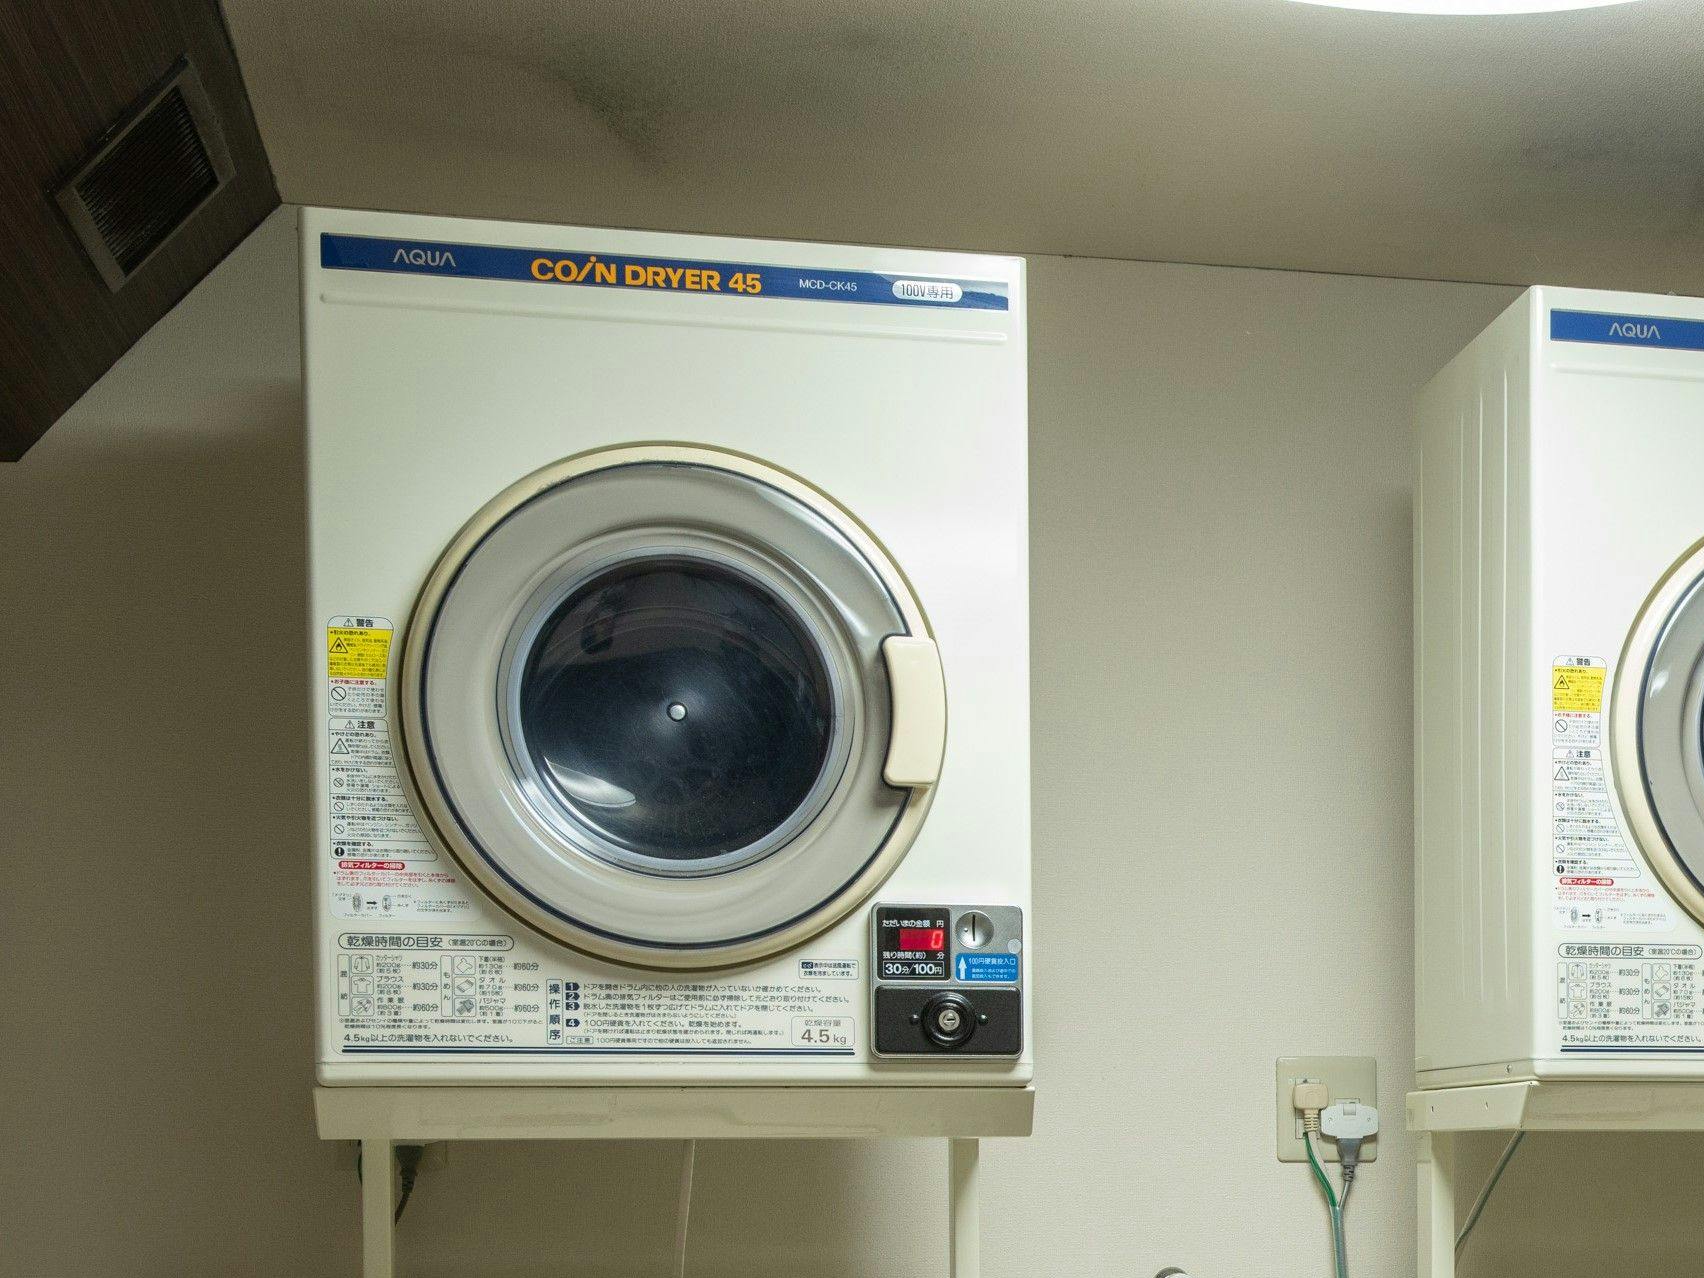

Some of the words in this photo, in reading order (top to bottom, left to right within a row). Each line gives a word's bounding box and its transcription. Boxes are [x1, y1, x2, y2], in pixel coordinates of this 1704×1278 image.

[393, 248, 457, 268] AQUA
[624, 264, 721, 293] DRYER
[728, 272, 762, 295] 45
[799, 278, 858, 293] MCD-CK45
[900, 282, 954, 300] 100V専用
[1608, 322, 1661, 340] AQUA
[357, 720, 375, 729] 注意
[936, 920, 944, 928] 円
[347, 935, 443, 948] 乾燥時間の目安
[930, 930, 944, 949] 0
[937, 952, 945, 960] 分
[1565, 945, 1644, 957] 乾燥時間の目安
[885, 963, 942, 975] 30分/100円
[801, 1029, 830, 1043] 4.5
[833, 1034, 847, 1045] kg
